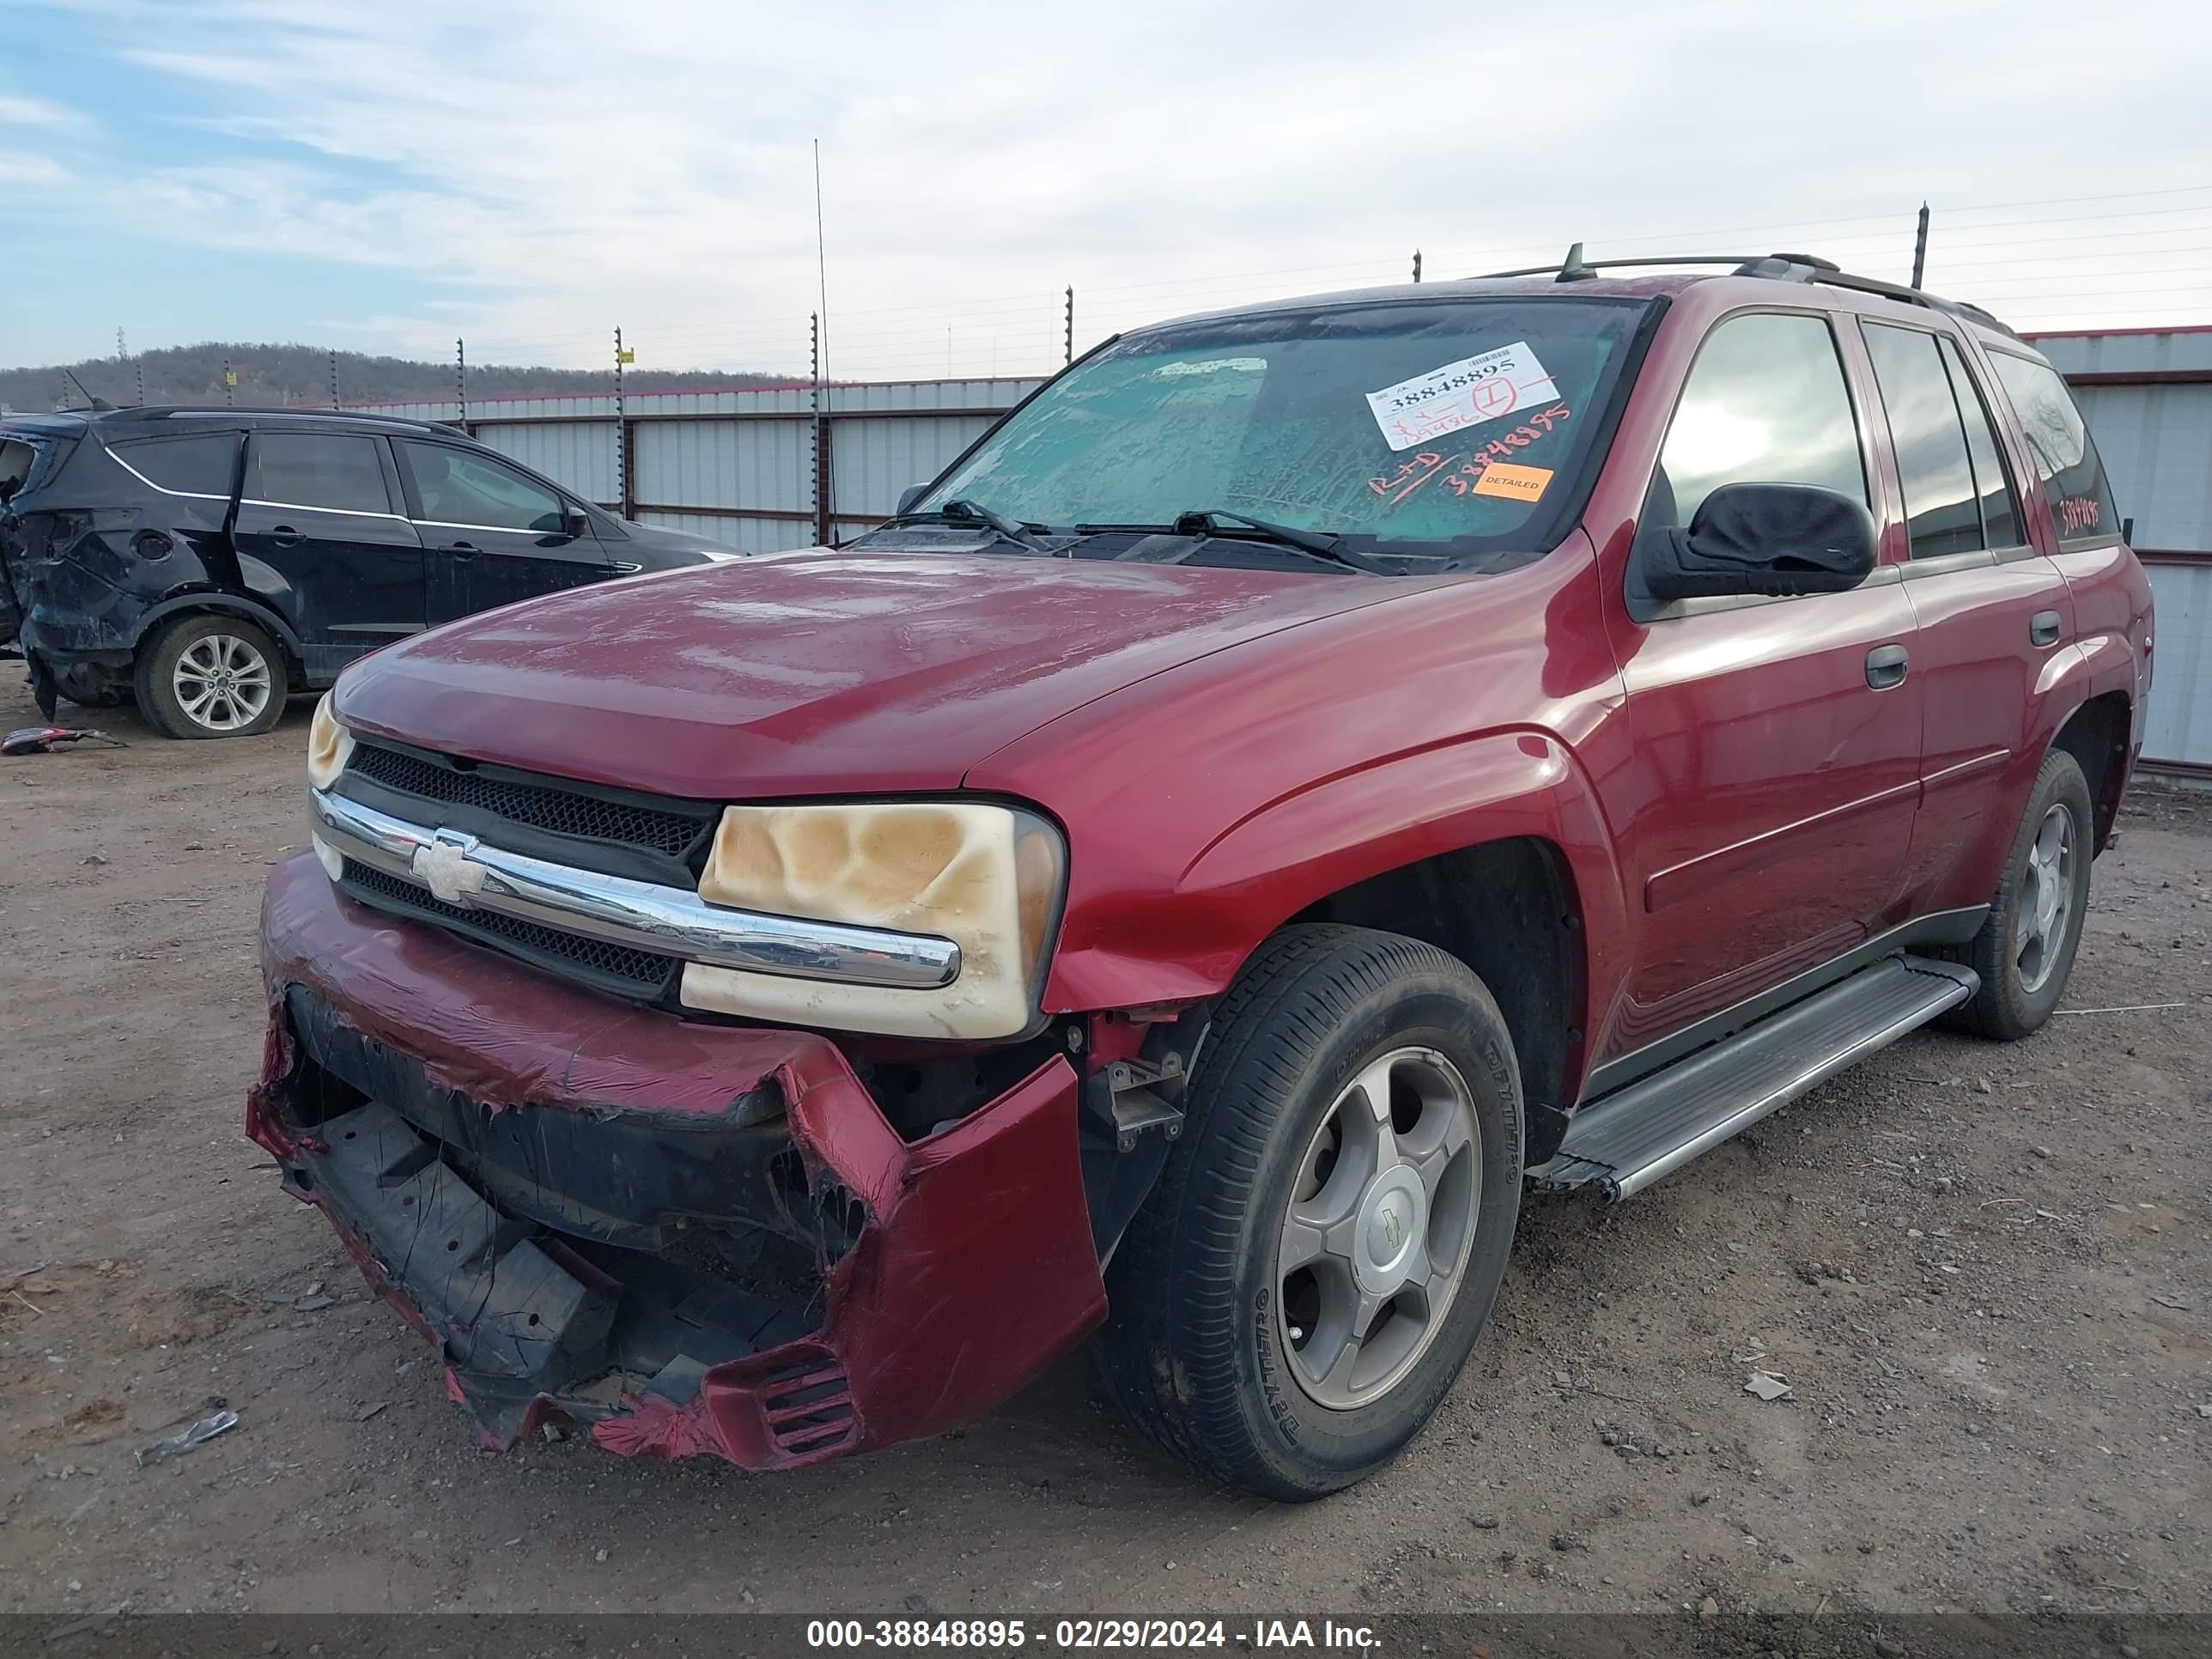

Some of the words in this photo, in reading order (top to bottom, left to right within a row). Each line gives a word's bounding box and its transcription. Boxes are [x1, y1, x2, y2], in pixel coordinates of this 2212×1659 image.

[1388, 358, 1516, 412] 38848895
[1439, 400, 1570, 496] 38848895
[1485, 475, 1540, 490] DETAILED
[1255, 1288, 1302, 1446] DEXTERO
